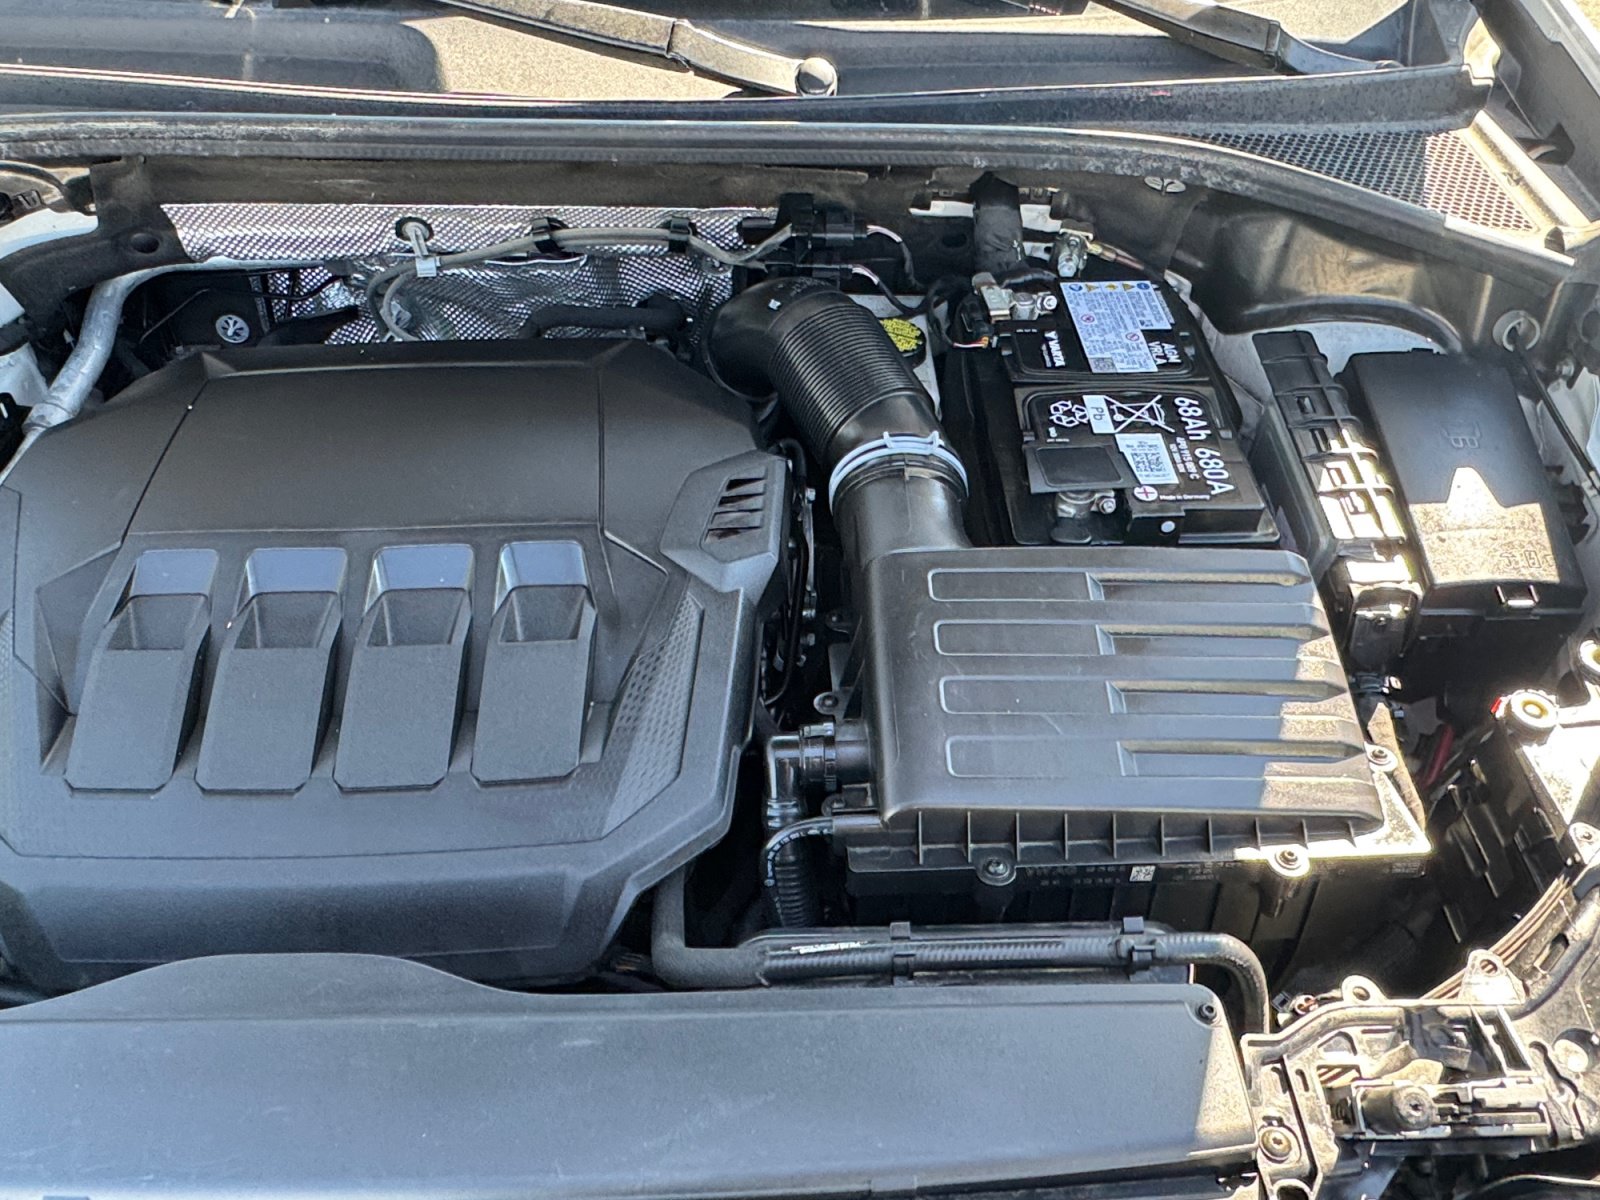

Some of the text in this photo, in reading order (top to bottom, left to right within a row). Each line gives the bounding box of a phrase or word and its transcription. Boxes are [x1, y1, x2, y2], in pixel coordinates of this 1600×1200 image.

[1148, 341, 1168, 365] VRLA
[1161, 342, 1182, 363] AGM
[1091, 406, 1106, 421] Pb
[1174, 396, 1211, 440] 68Ah
[1194, 447, 1235, 495] 680A
